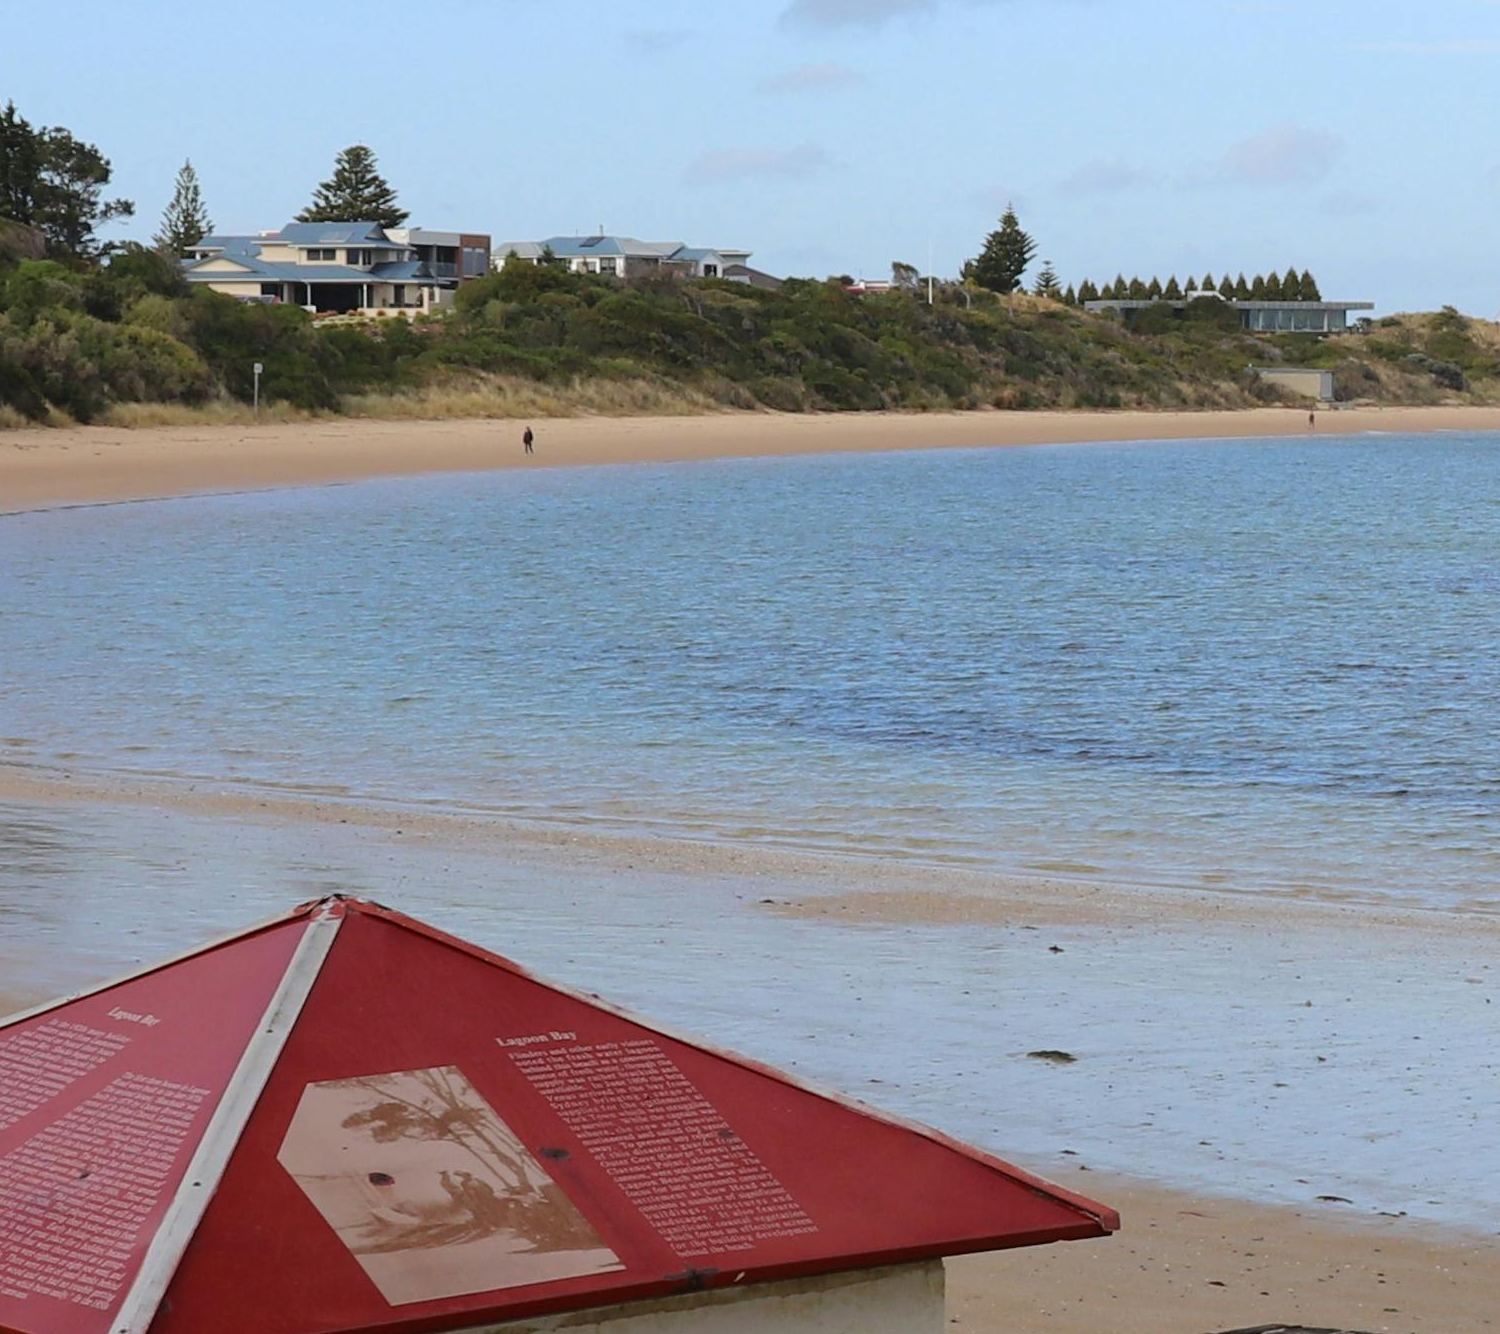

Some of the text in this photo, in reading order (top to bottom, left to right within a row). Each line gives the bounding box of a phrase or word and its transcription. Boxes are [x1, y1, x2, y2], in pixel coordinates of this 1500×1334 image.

[108, 1006, 161, 1027] Lagoon Bay
[495, 1031, 577, 1047] Lagoon Bay
